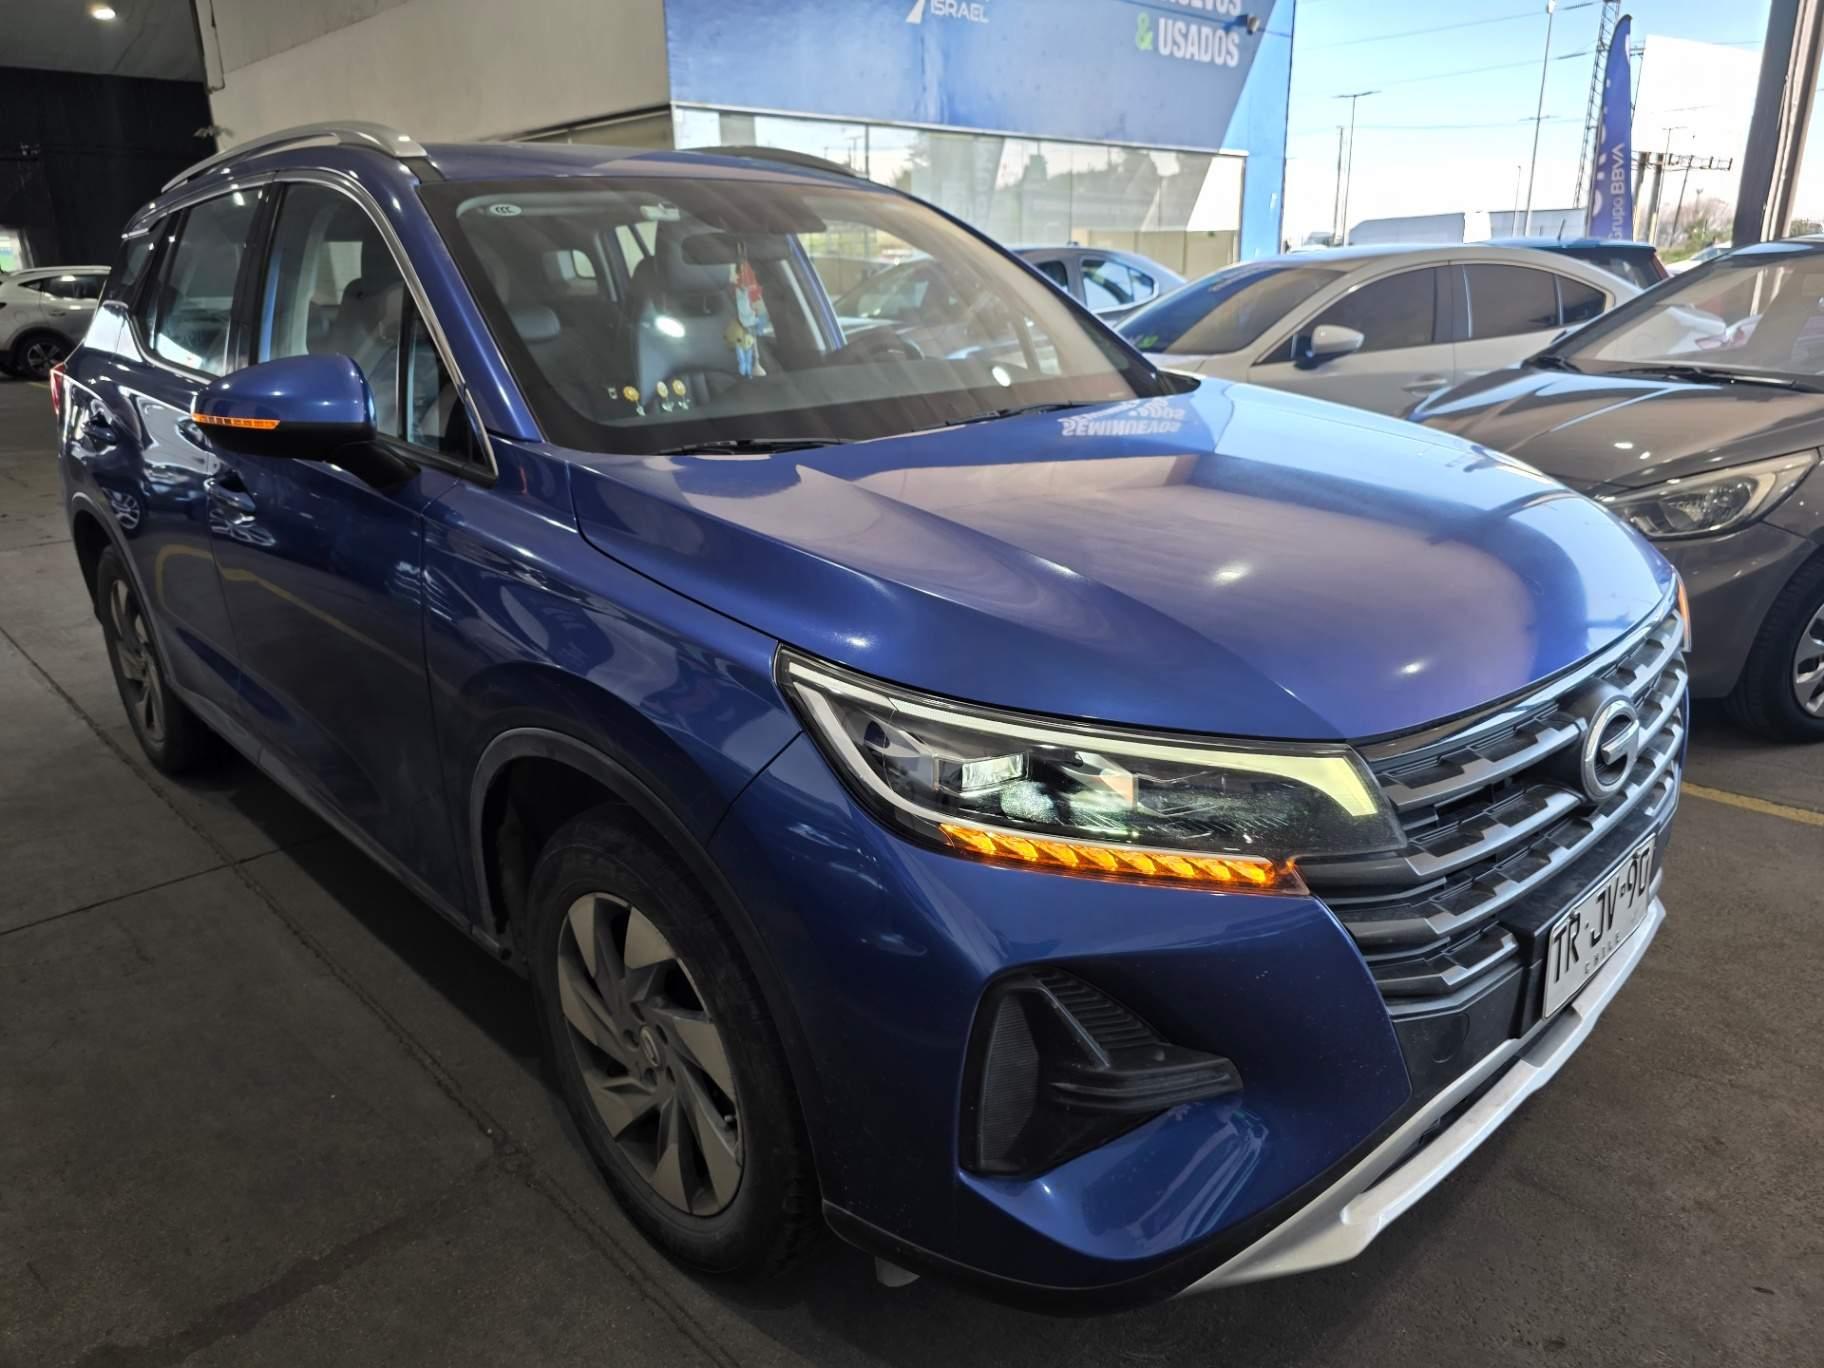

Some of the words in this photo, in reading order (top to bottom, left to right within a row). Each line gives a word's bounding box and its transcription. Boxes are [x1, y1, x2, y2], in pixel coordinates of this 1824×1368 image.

[930, 0, 990, 23] ISRAEL
[1136, 11, 1153, 50] &
[1158, 17, 1239, 67] USADOS
[1610, 143, 1625, 194] BBVA
[1608, 197, 1626, 240] Grupo
